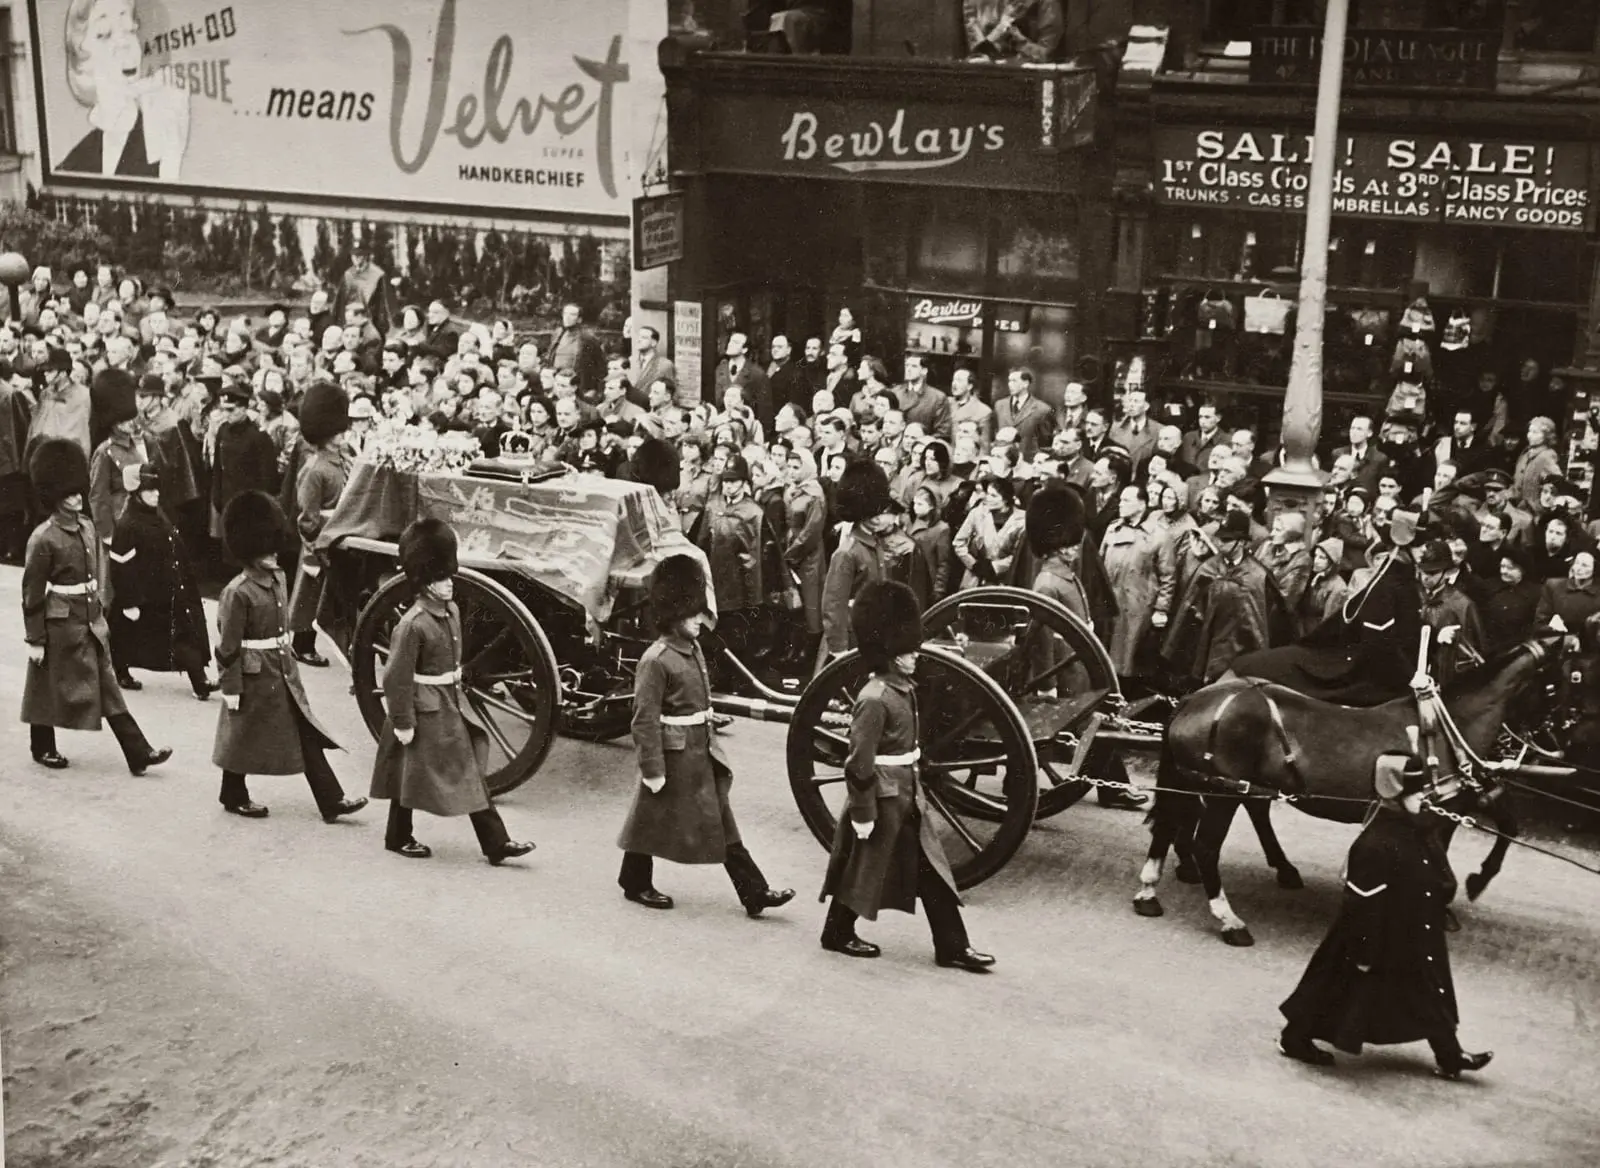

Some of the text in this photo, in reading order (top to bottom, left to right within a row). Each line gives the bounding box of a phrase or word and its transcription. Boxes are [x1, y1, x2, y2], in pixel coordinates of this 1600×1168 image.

[1309, 36, 1393, 63] IDIA
[160, 59, 232, 104] TISSUE
[340, 0, 629, 199] Velvet
[781, 109, 1004, 172] Bewlay's
[1387, 140, 1554, 175] SALE!
[458, 164, 585, 187] HANDKERCHIEF
[1199, 163, 1264, 188] Class
[1271, 166, 1355, 194] Gods
[1363, 179, 1389, 196] At
[1442, 175, 1510, 202] Class
[1514, 178, 1588, 207] Prices
[1165, 187, 1583, 225] TRUNKS CASES MBRELLAS FANCY GOODS
[914, 299, 982, 323] Bewlay
[972, 317, 1020, 331] PES
